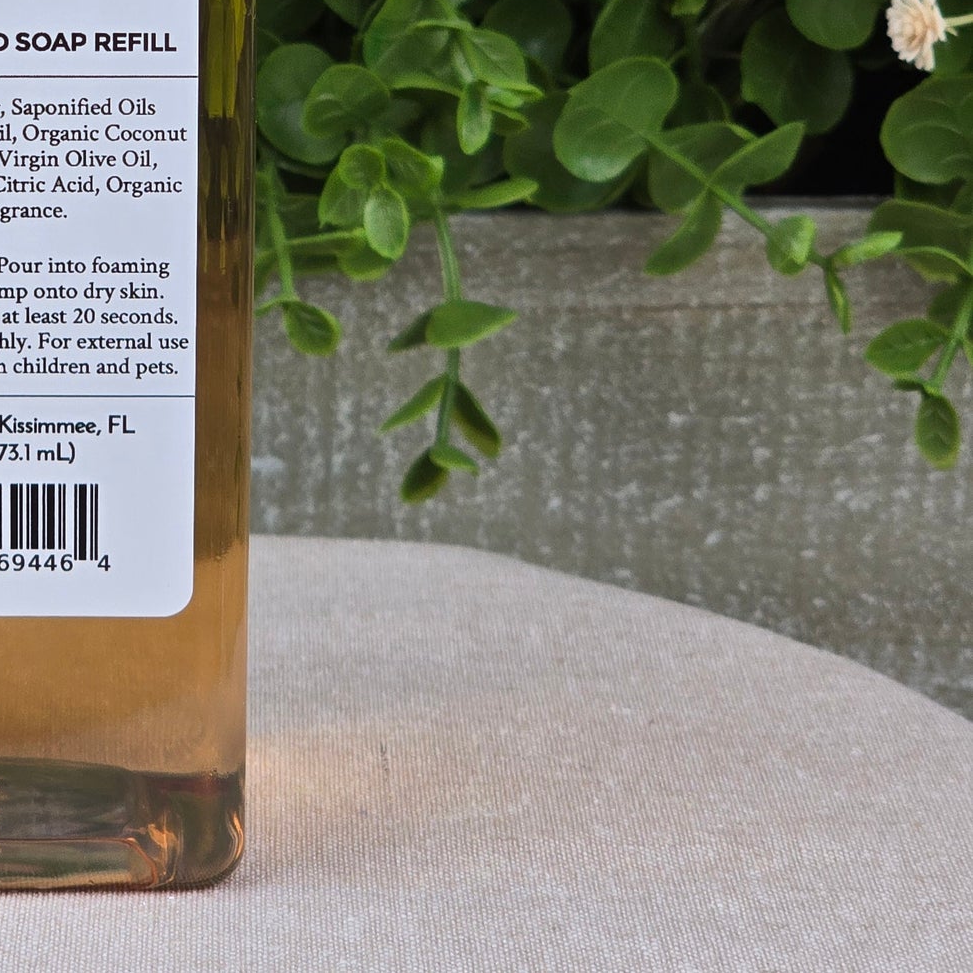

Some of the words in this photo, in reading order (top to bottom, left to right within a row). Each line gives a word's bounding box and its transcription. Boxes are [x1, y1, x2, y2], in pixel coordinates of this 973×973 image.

[14, 31, 87, 52] SOAP
[94, 32, 178, 52] REFILL
[11, 97, 113, 121] Saponified
[118, 97, 156, 116] Oils
[22, 123, 100, 146] Organic
[104, 123, 188, 142] Coconut
[65, 149, 117, 168] Olive
[122, 149, 158, 171] Oil,
[50, 174, 100, 197] Acid,
[106, 175, 183, 199] Organic
[47, 257, 87, 274] into
[91, 255, 170, 280] foaming
[33, 285, 78, 299] onto
[83, 281, 116, 304] dry
[119, 281, 165, 300] skin.
[1, 310, 20, 325] at
[24, 306, 68, 325] least
[72, 307, 96, 324] 20
[100, 306, 178, 325] seconds.
[38, 331, 73, 350] For
[76, 332, 153, 350] external
[157, 337, 190, 350] use
[12, 356, 91, 375] children
[96, 356, 131, 375] and
[135, 360, 179, 380] pets.
[108, 414, 136, 434] FL
[36, 441, 76, 465] mL)
